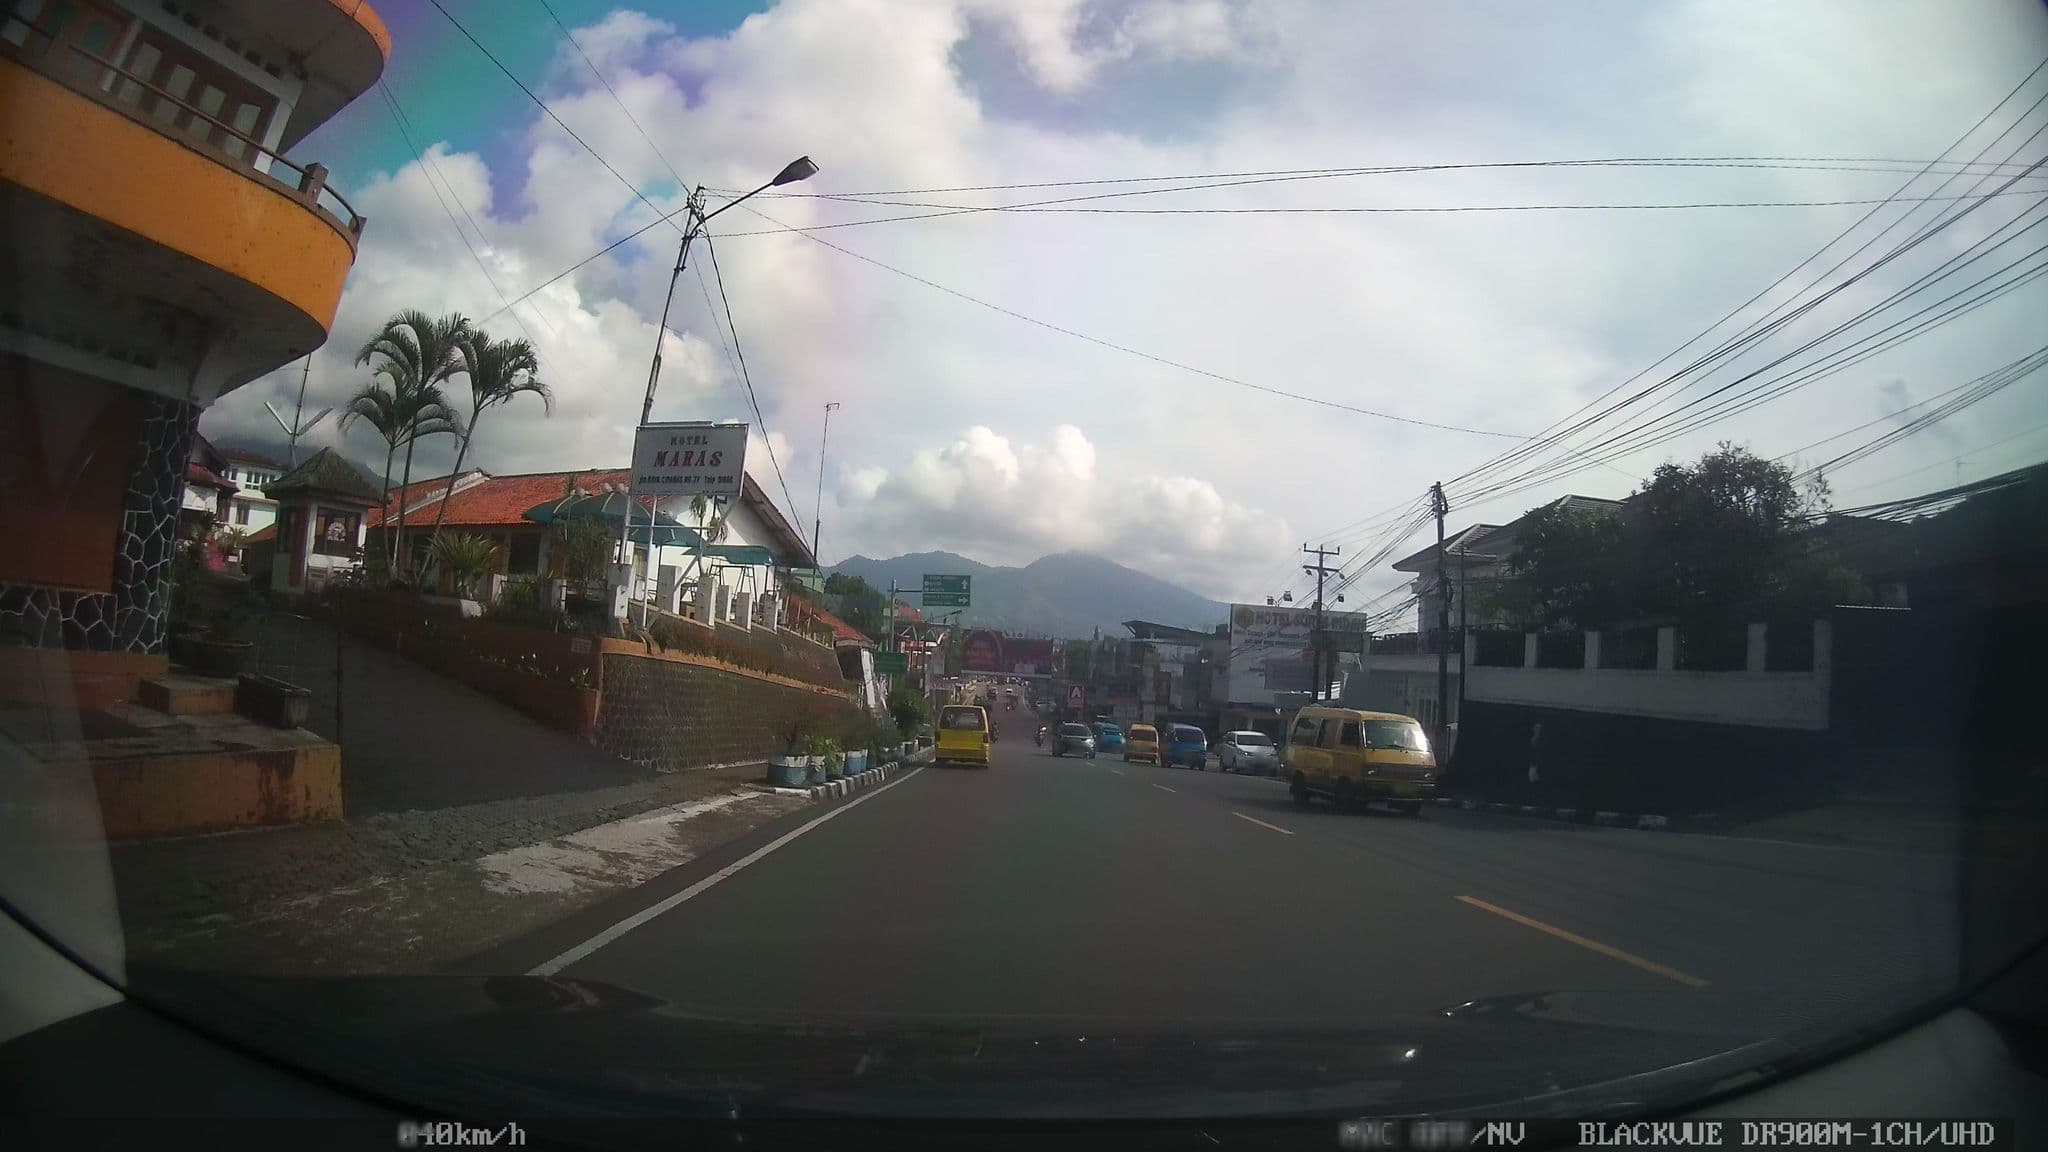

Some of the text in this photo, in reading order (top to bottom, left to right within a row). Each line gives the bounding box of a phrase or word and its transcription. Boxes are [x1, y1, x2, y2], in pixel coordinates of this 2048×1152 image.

[670, 435, 709, 446] HOTEL
[654, 450, 723, 467] MARAS
[1256, 610, 1290, 626] HOTEL
